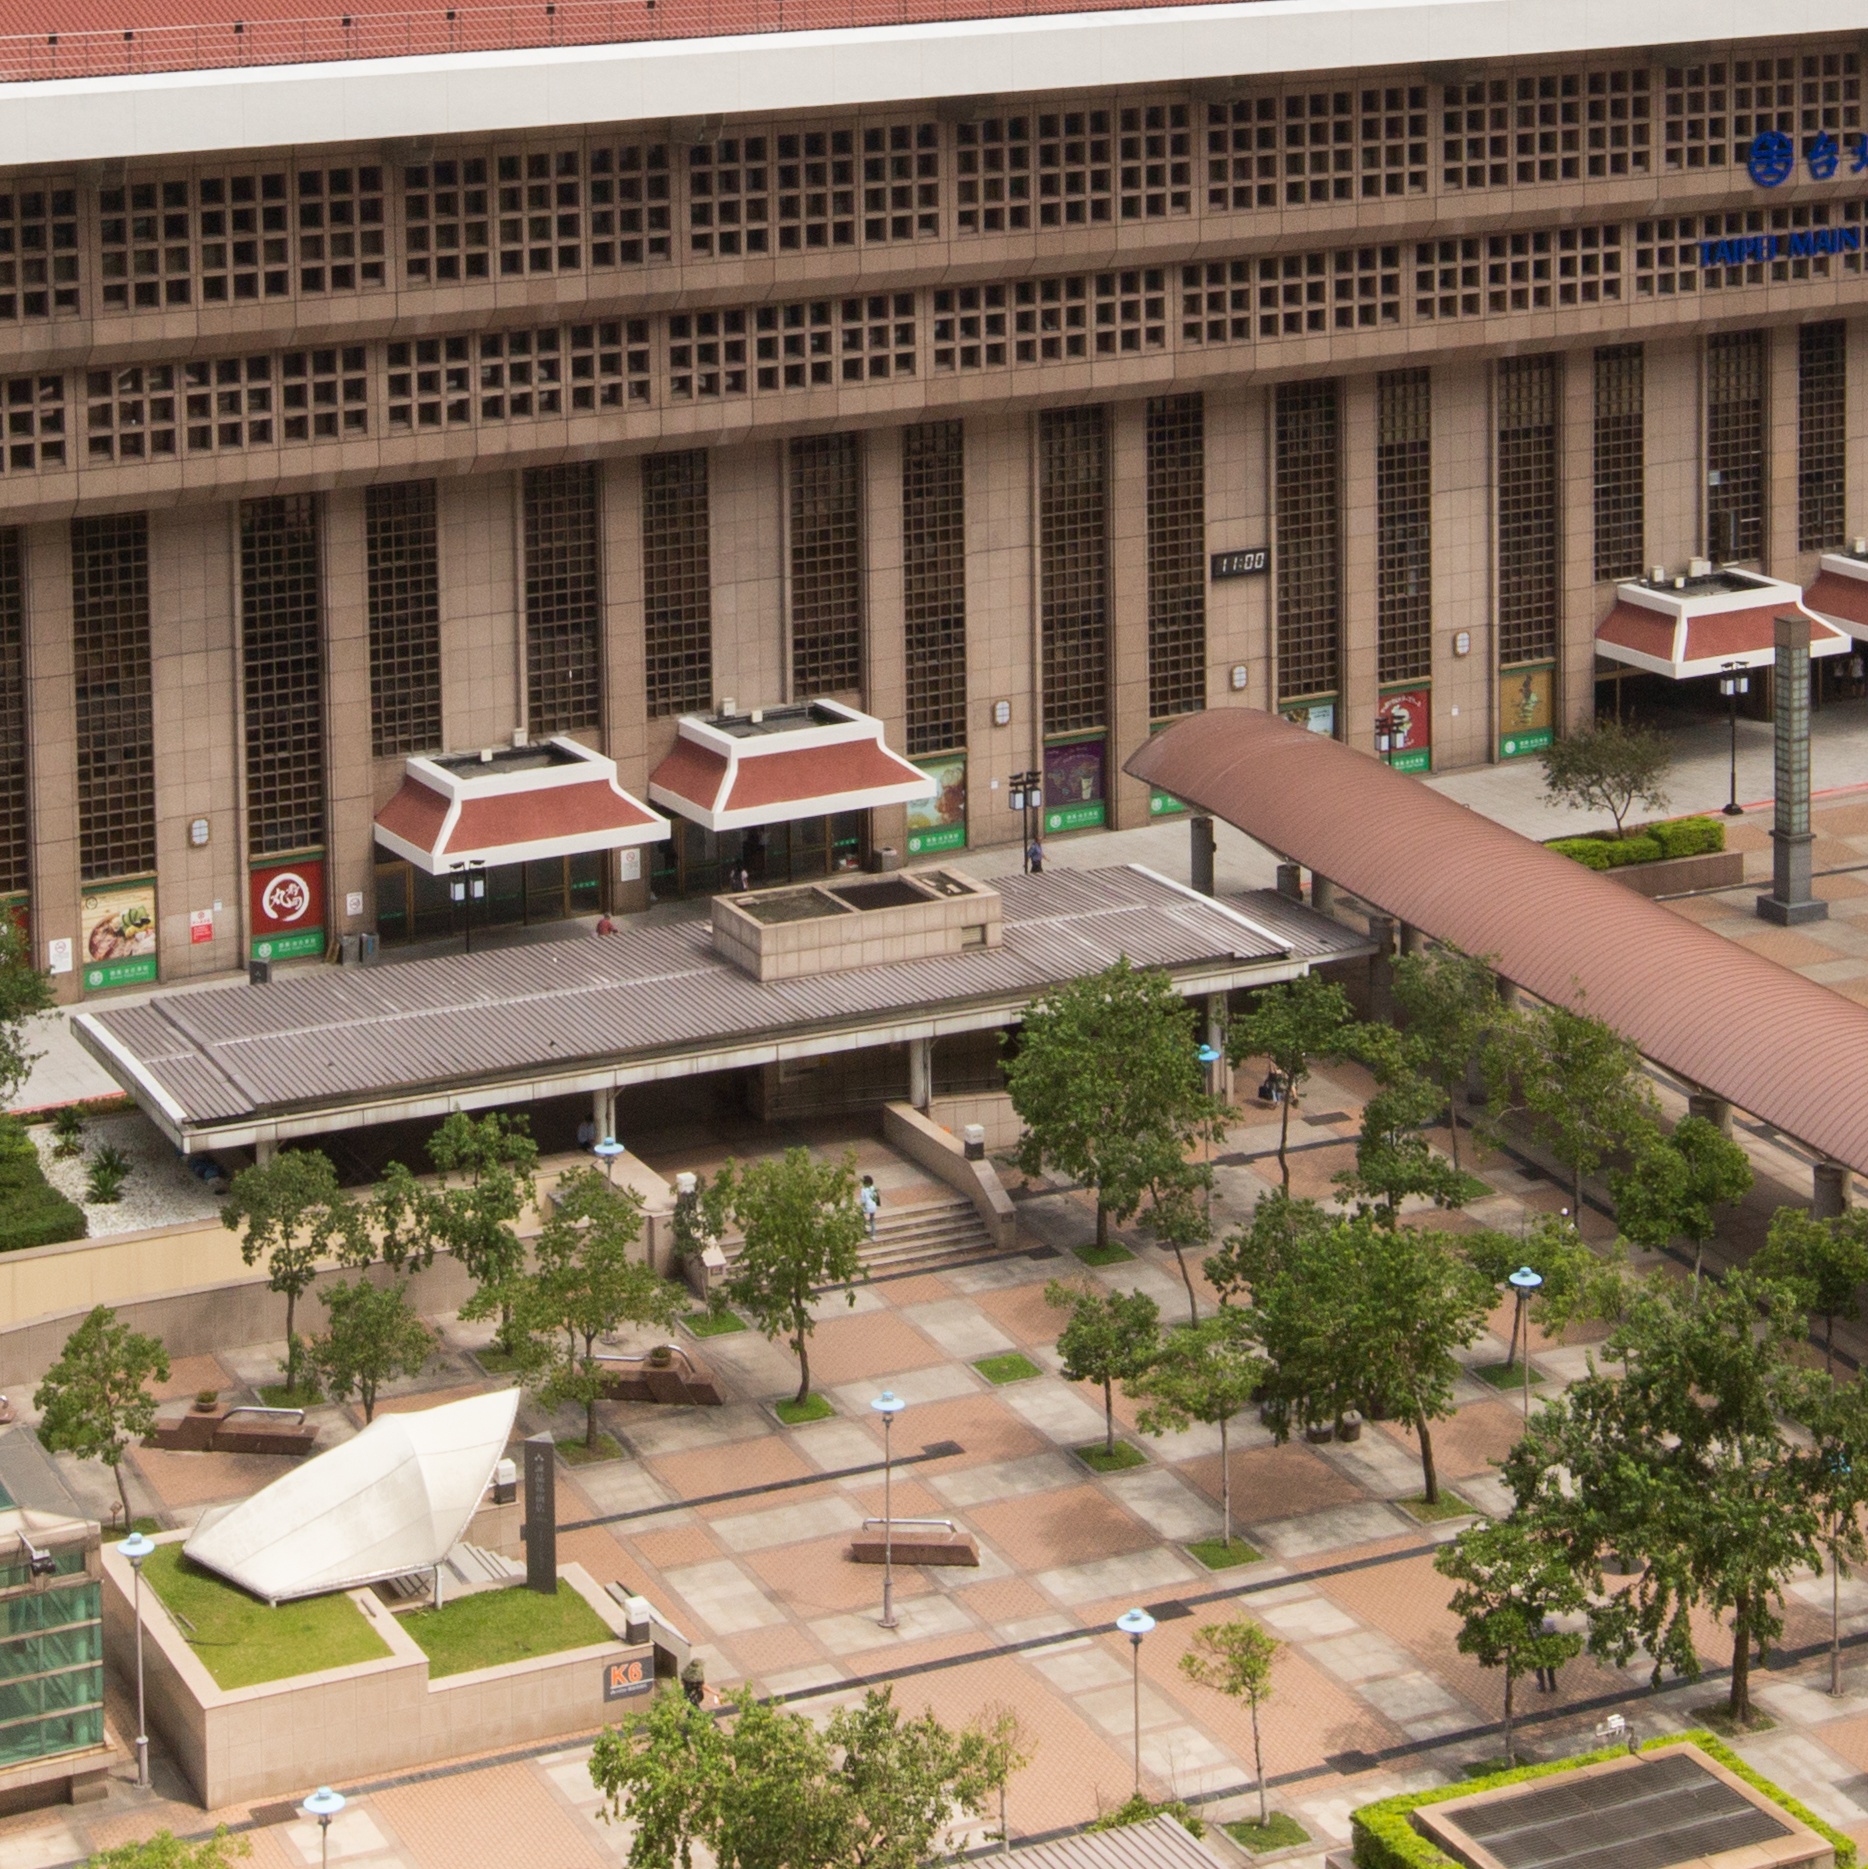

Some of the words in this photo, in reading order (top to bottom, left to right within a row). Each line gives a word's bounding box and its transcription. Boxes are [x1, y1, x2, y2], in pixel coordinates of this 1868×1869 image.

[1699, 235, 1777, 267] TAIPEI
[1788, 227, 1860, 258] MAIN
[1222, 552, 1265, 572] 11:00
[610, 1661, 643, 1687] K6
